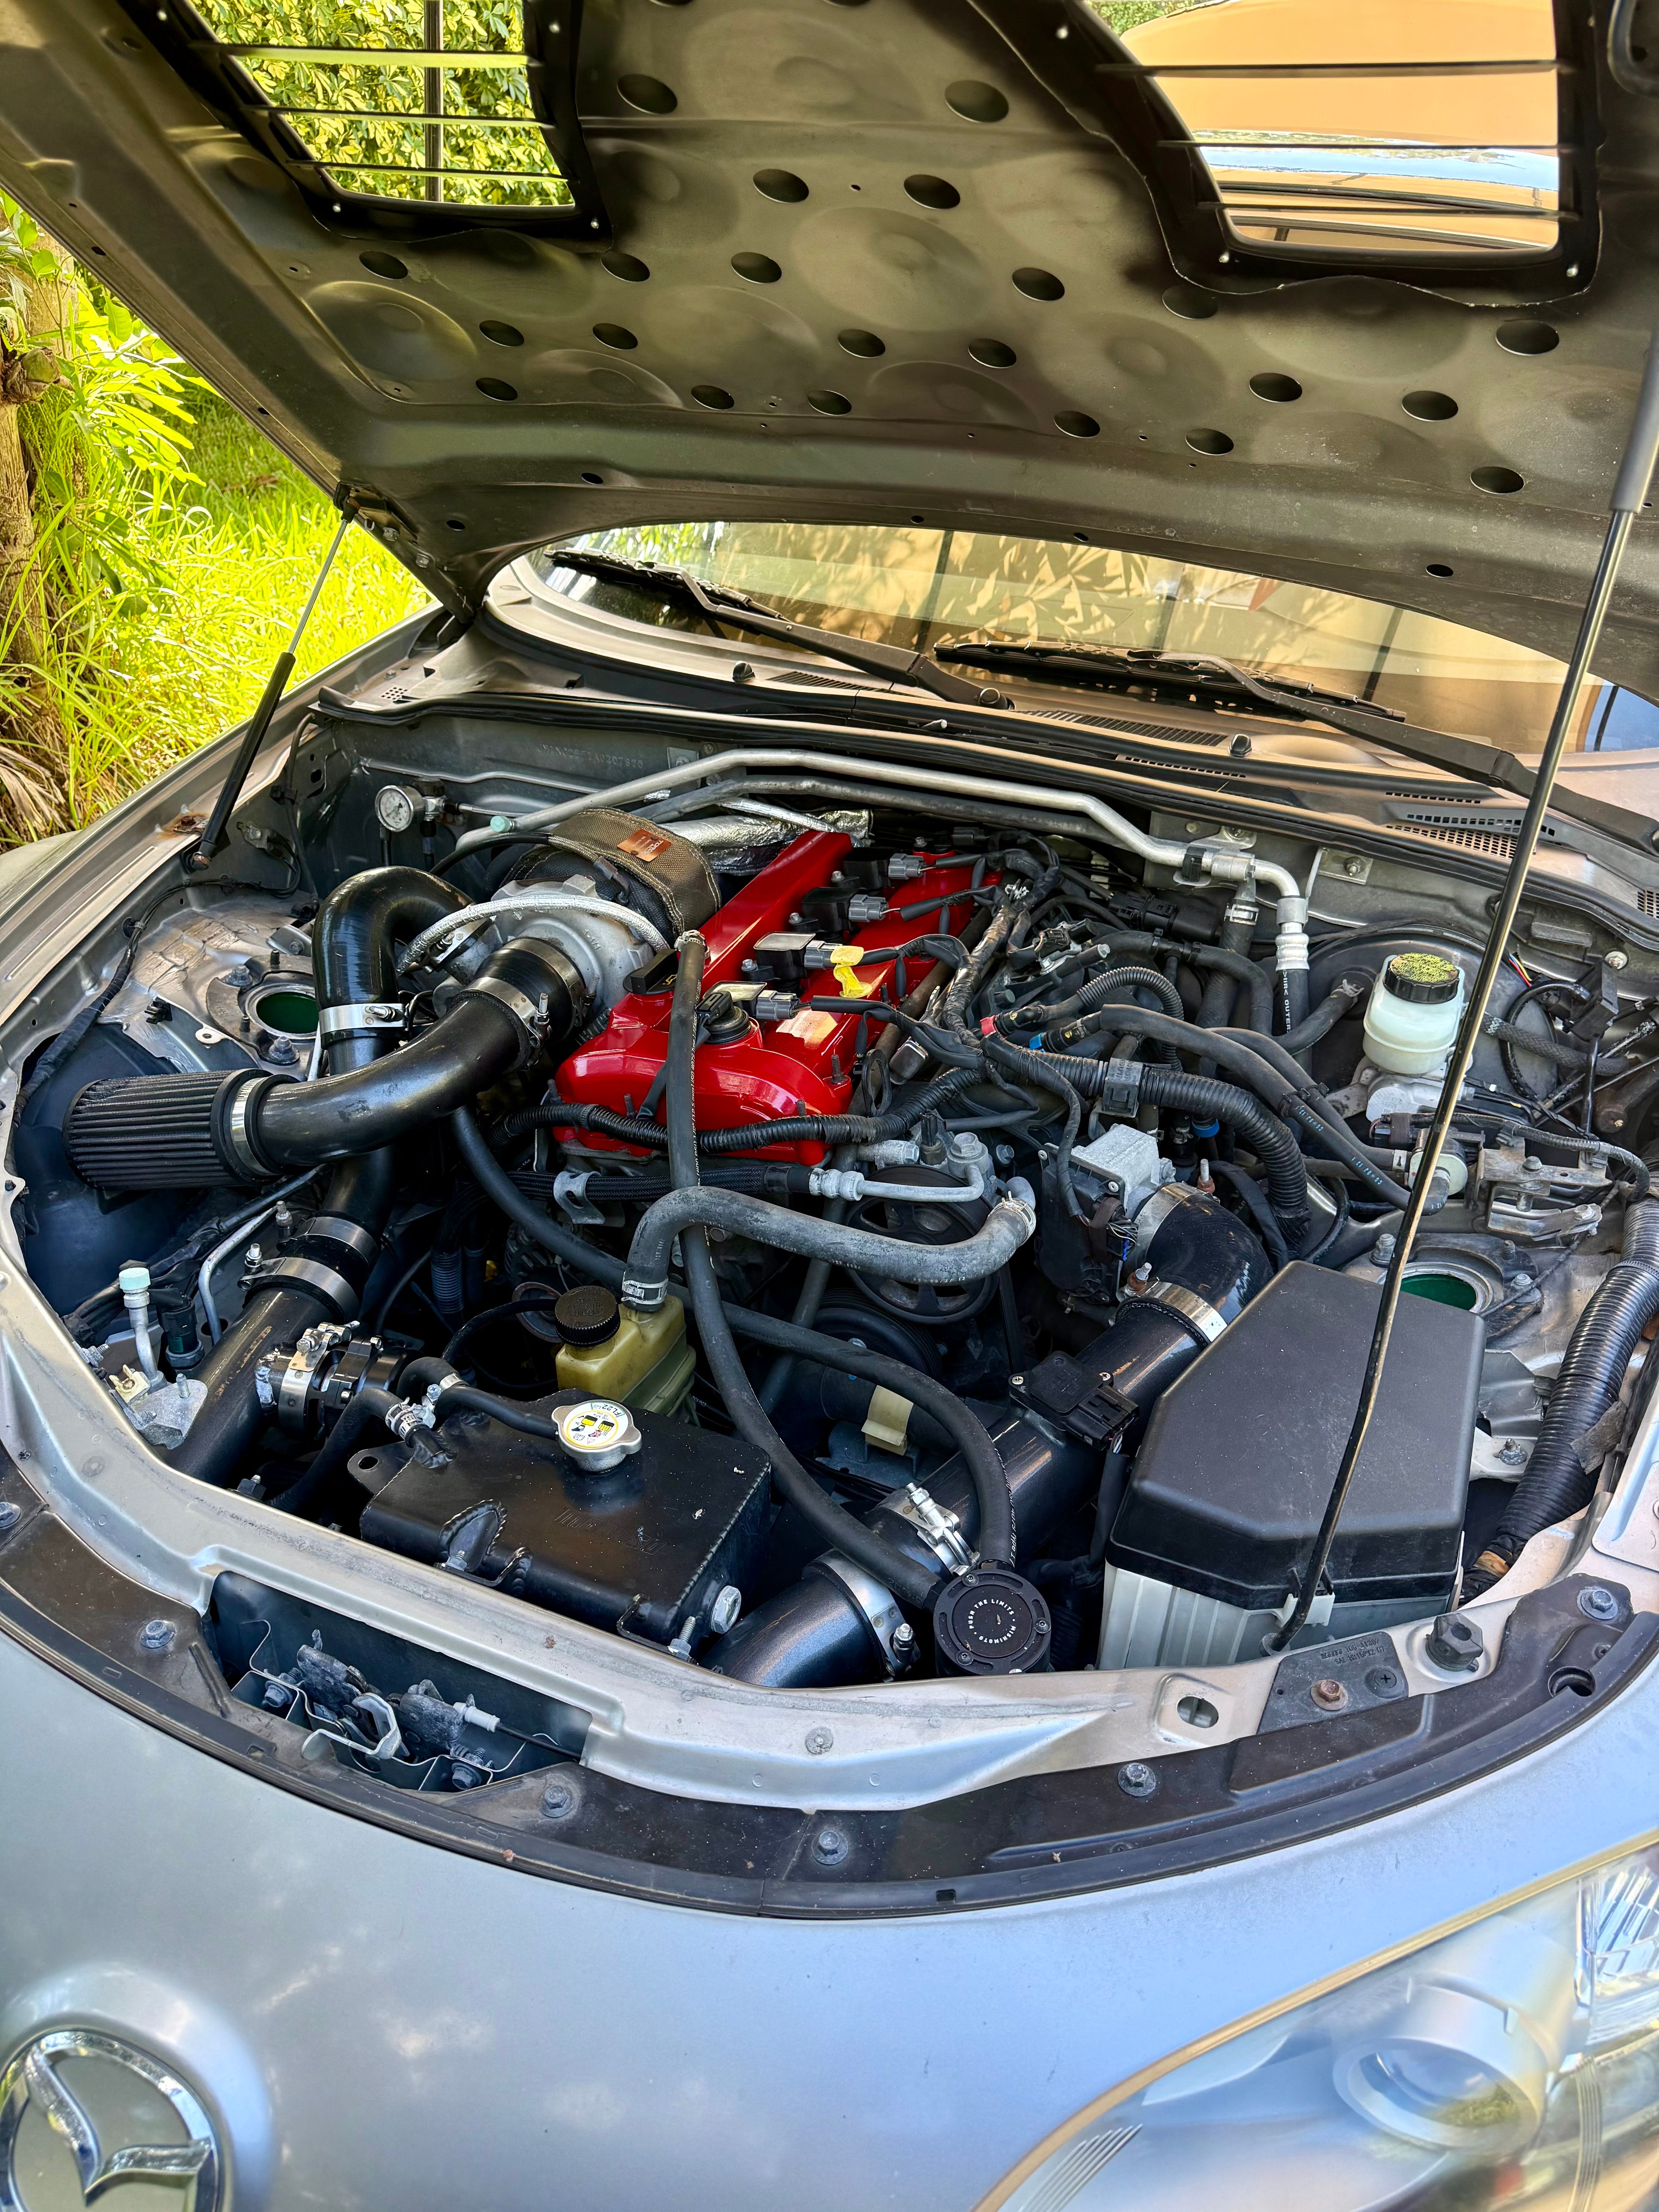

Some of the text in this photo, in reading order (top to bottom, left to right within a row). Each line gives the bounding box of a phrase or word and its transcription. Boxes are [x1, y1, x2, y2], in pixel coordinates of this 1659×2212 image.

[602, 1405, 622, 1415] FL22
[974, 1599, 988, 1609] THE
[991, 1599, 1015, 1615] LIMITS
[978, 1625, 1017, 1644] MISHIMOTO
